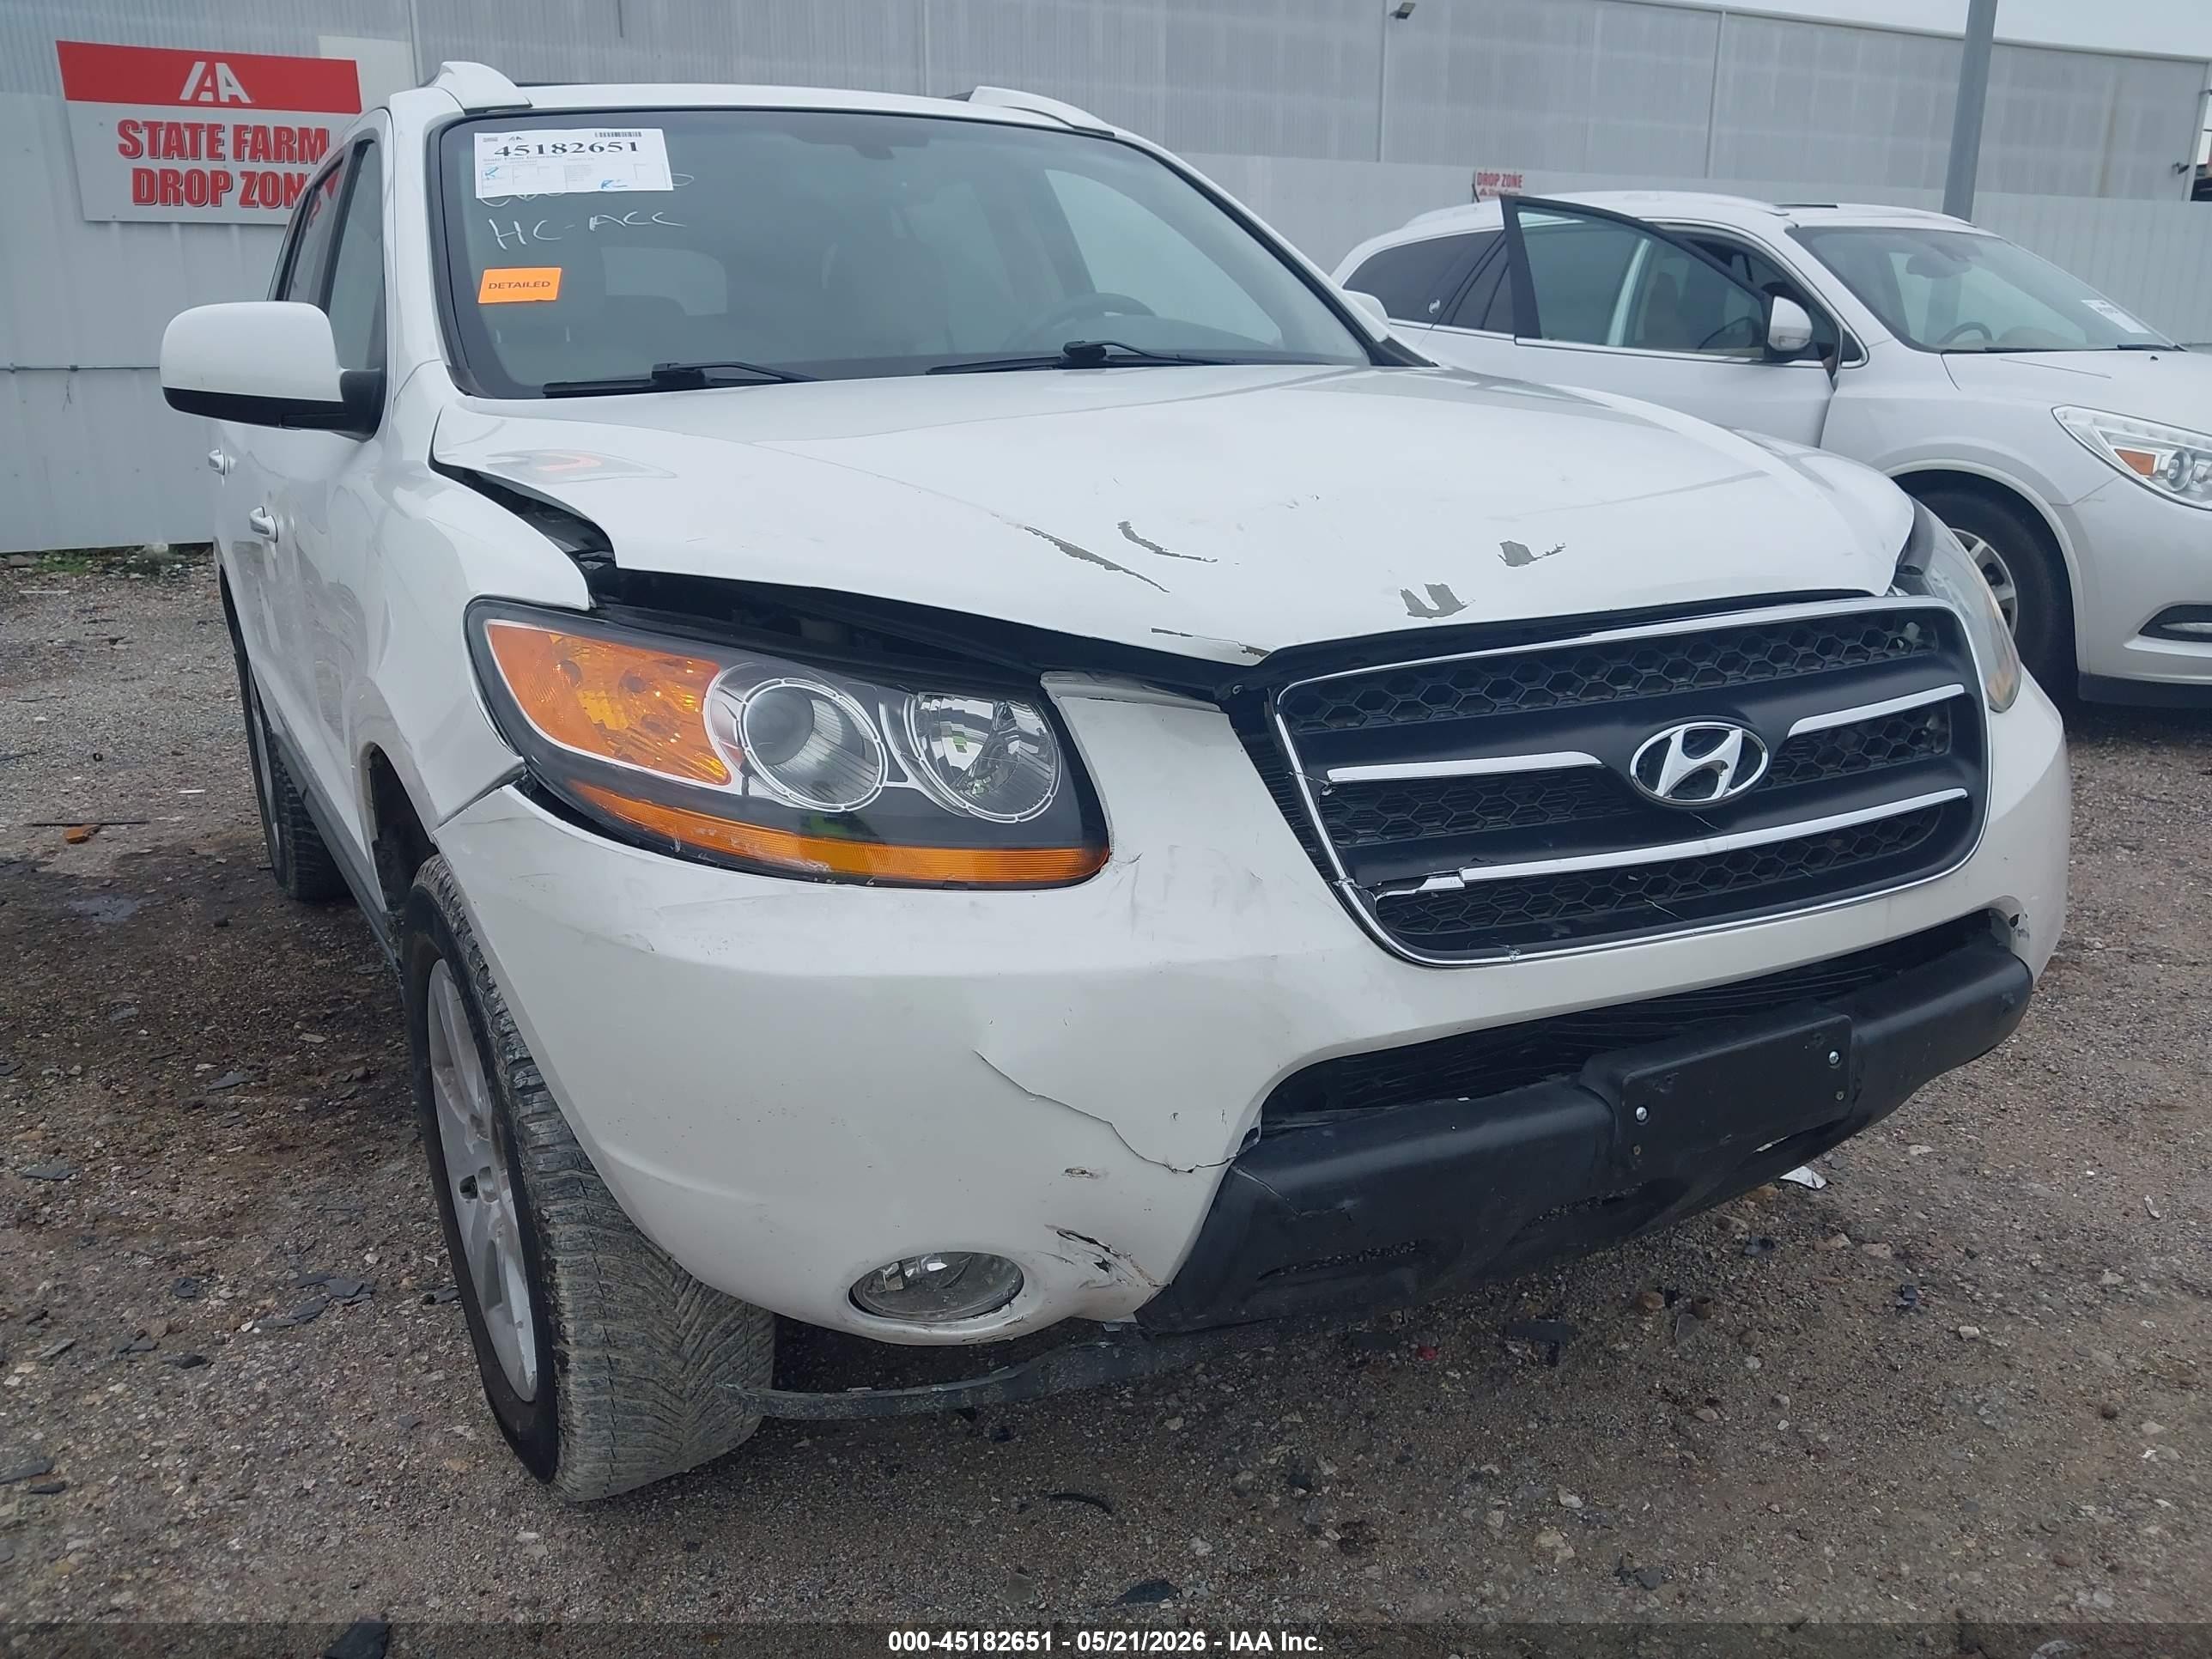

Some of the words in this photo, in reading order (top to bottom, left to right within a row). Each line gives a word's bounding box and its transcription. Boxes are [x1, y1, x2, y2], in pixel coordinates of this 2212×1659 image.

[116, 118, 226, 161] STATE
[232, 124, 331, 166] FARM
[494, 140, 639, 158] 45182651
[131, 167, 234, 208] DROP
[238, 170, 311, 209] ZON
[1476, 172, 1500, 186] DROP
[1501, 173, 1523, 189] ZONE
[488, 281, 550, 290] DETAILED
